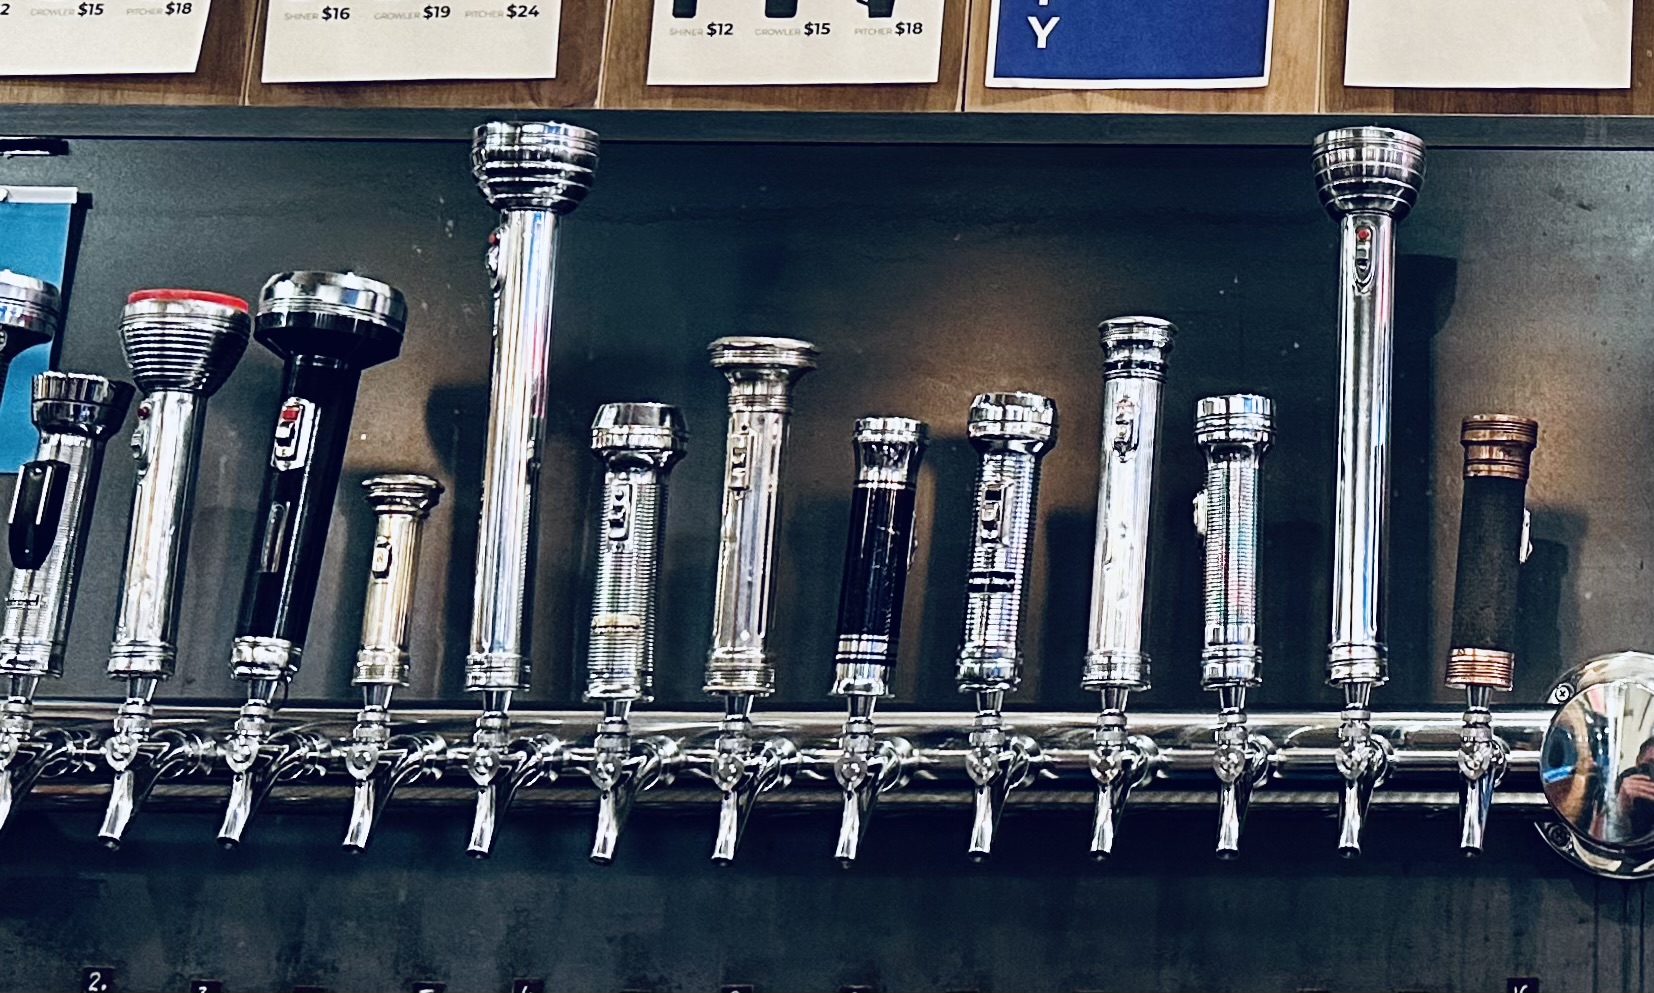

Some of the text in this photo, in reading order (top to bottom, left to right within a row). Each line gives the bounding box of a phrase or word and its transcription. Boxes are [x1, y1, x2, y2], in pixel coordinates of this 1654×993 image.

[322, 6, 350, 21] $16
[423, 5, 451, 20] $19
[506, 3, 539, 19] $24
